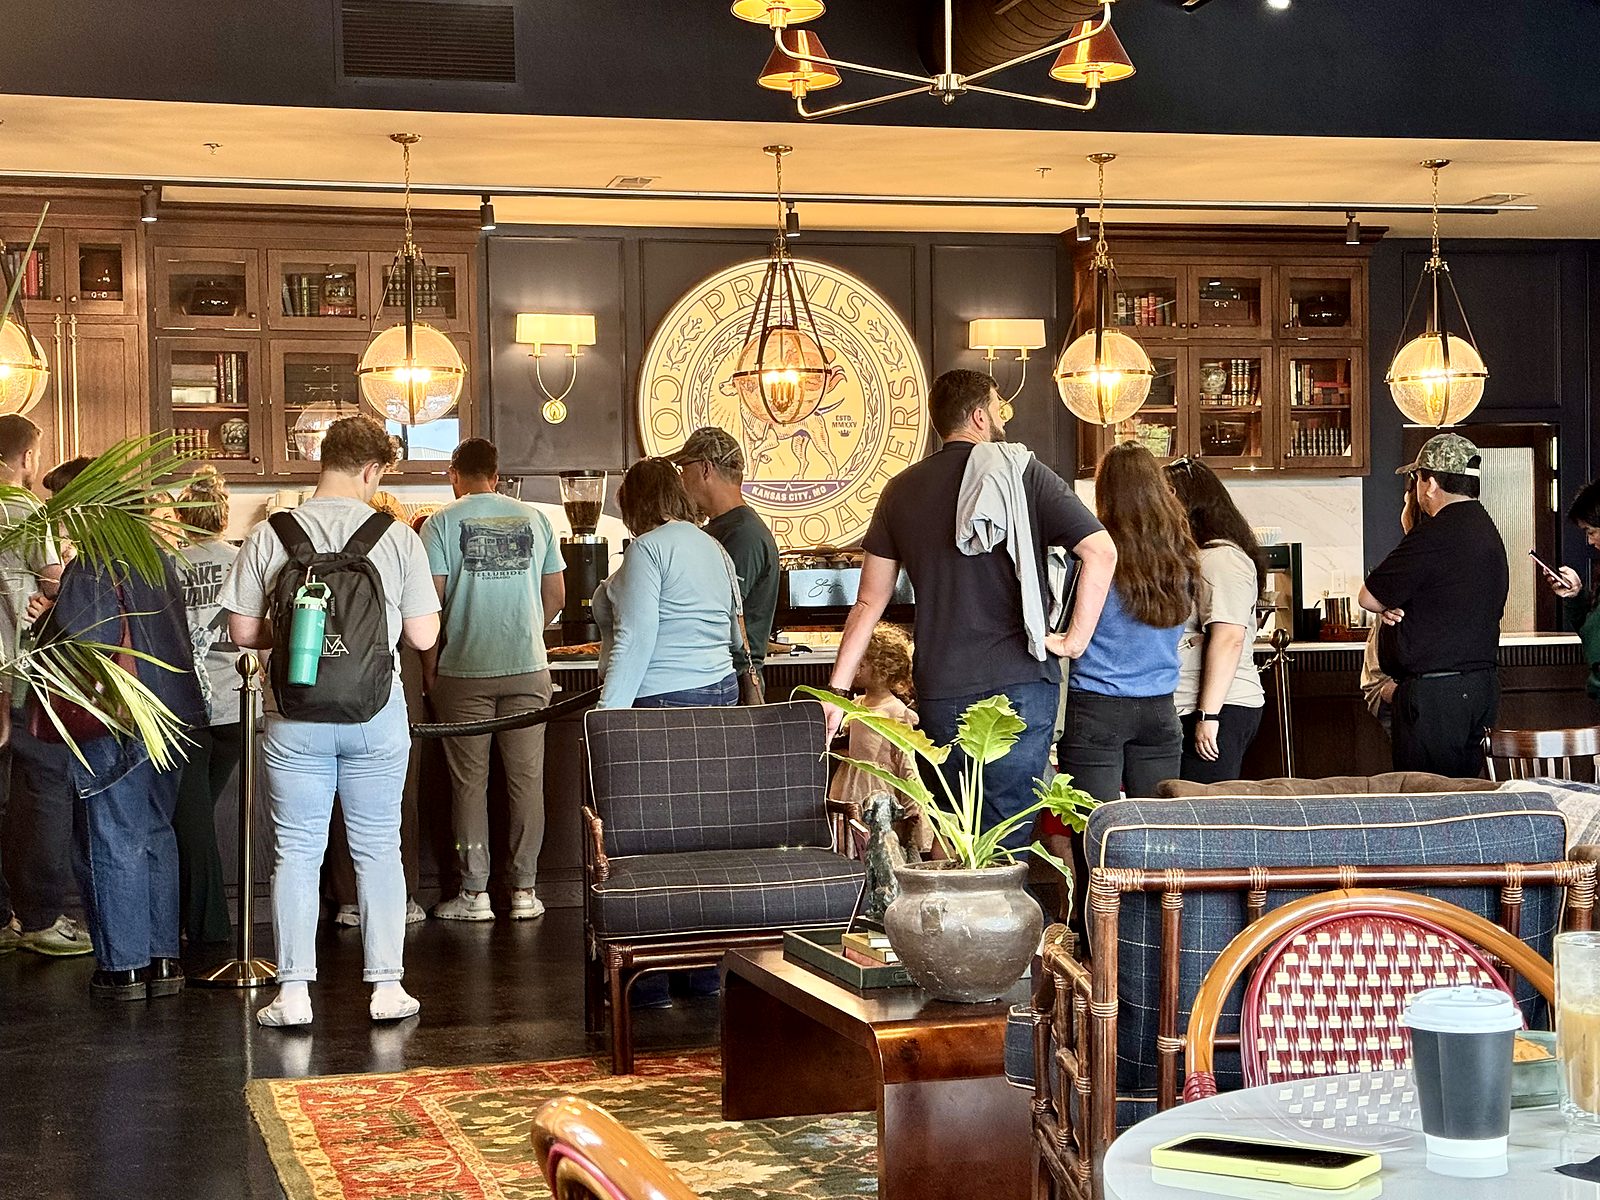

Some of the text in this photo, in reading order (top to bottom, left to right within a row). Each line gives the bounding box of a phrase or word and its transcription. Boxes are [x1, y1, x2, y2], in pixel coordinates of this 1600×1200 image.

[772, 376, 920, 549] ROASTERS
[751, 486, 787, 501] KANSAS
[812, 485, 827, 497] MO
[470, 570, 523, 578] TELLURIDE
